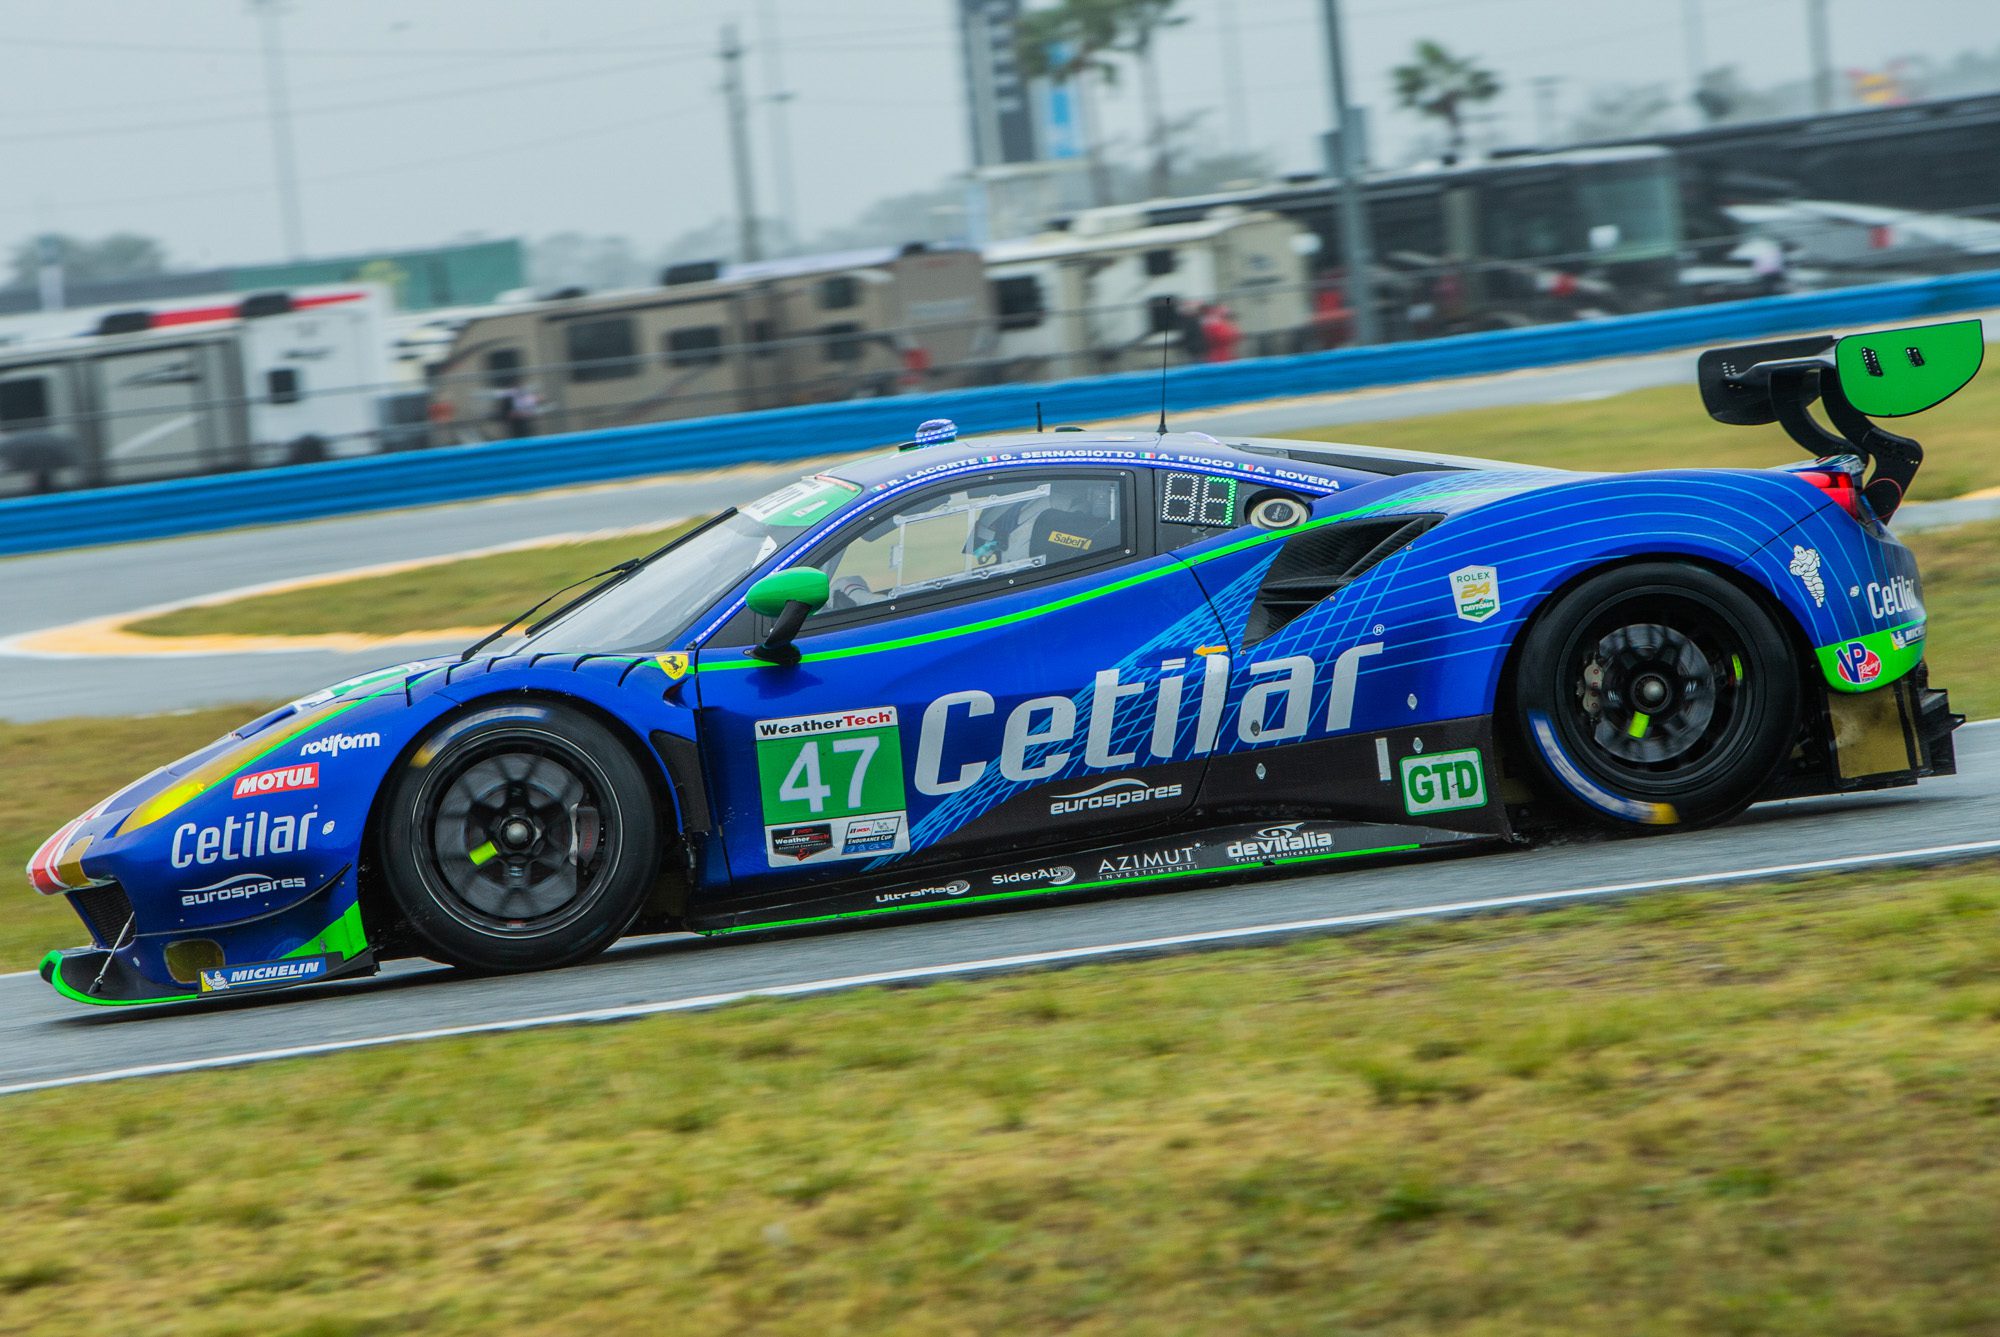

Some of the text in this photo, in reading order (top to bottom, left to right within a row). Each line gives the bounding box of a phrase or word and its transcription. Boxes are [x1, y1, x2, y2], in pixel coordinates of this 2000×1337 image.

[1021, 450, 1136, 459] SERNAGIOTTO
[1158, 453, 1235, 468] A. FUOCO
[887, 457, 979, 486] R. LACORTE
[1254, 465, 1340, 489] A. ROVERA
[1456, 571, 1490, 583] ROLEX
[1461, 581, 1490, 599] 24
[1836, 641, 1868, 684] VP
[759, 712, 892, 736] WeatherTech
[300, 732, 381, 757] rotiform
[236, 767, 316, 796] MOTUL
[779, 735, 880, 813] 47
[1408, 760, 1479, 804] GTD
[1050, 783, 1182, 815] eurospares
[1227, 831, 1333, 858] devitalia
[1235, 847, 1329, 863] Telecomunicazioni
[1098, 847, 1193, 873] AZIMUT
[1099, 864, 1198, 880] INVESTIMENTI
[181, 877, 306, 906] eurospares
[230, 961, 320, 983] MICHELIN
